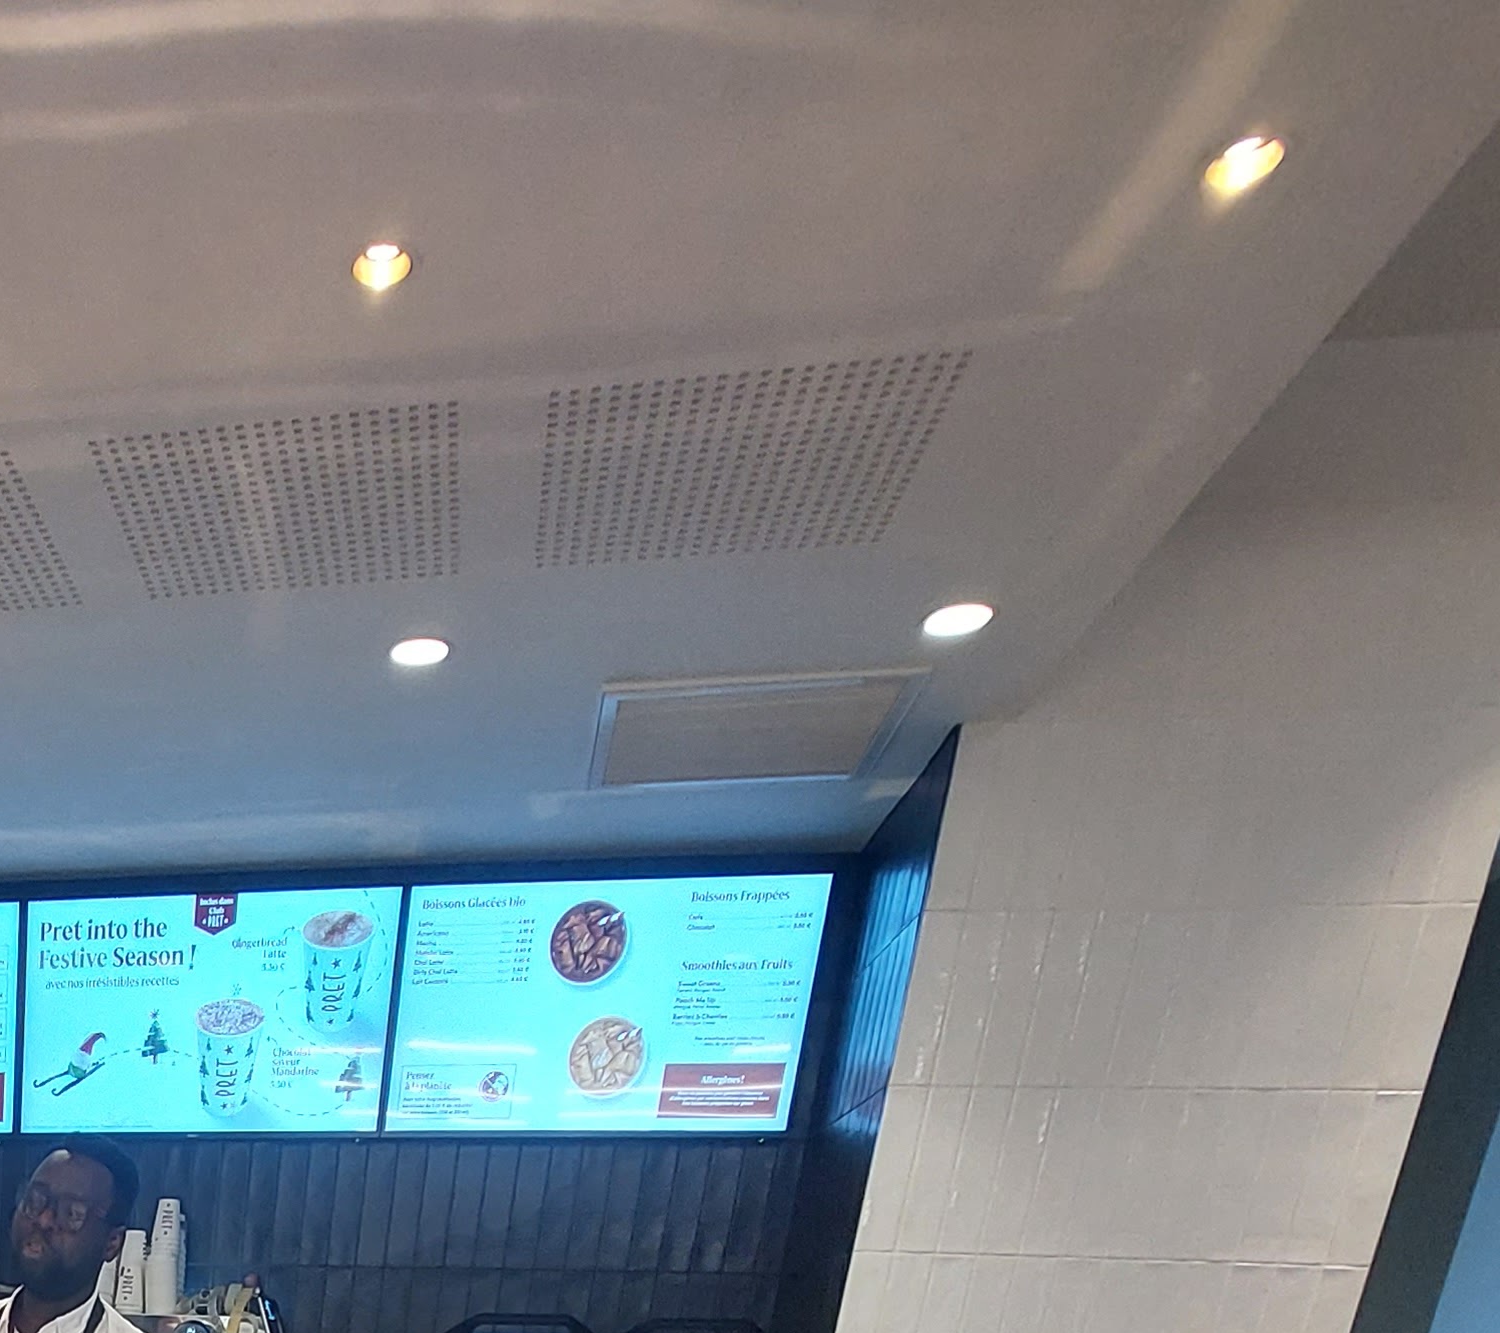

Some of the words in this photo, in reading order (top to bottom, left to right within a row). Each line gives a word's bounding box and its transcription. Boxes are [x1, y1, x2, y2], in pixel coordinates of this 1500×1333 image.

[422, 898, 466, 910] Boissons
[467, 896, 507, 908] Glacées
[508, 895, 526, 908] bio
[691, 890, 738, 903] Boissons
[740, 889, 790, 904] Frappées
[40, 919, 82, 942] Pret
[87, 918, 128, 941] into
[133, 917, 167, 939] the
[231, 937, 288, 950] Gingerbread
[39, 946, 108, 970] Festive
[112, 947, 184, 967] Season
[681, 959, 737, 971] Smoothies
[761, 958, 793, 970] Fruits
[45, 979, 67, 989] avec
[67, 979, 84, 989] nos
[85, 976, 140, 988] irrésistibles
[141, 976, 180, 988] recettes
[322, 972, 347, 1012] PRET
[215, 1058, 238, 1097] PRET
